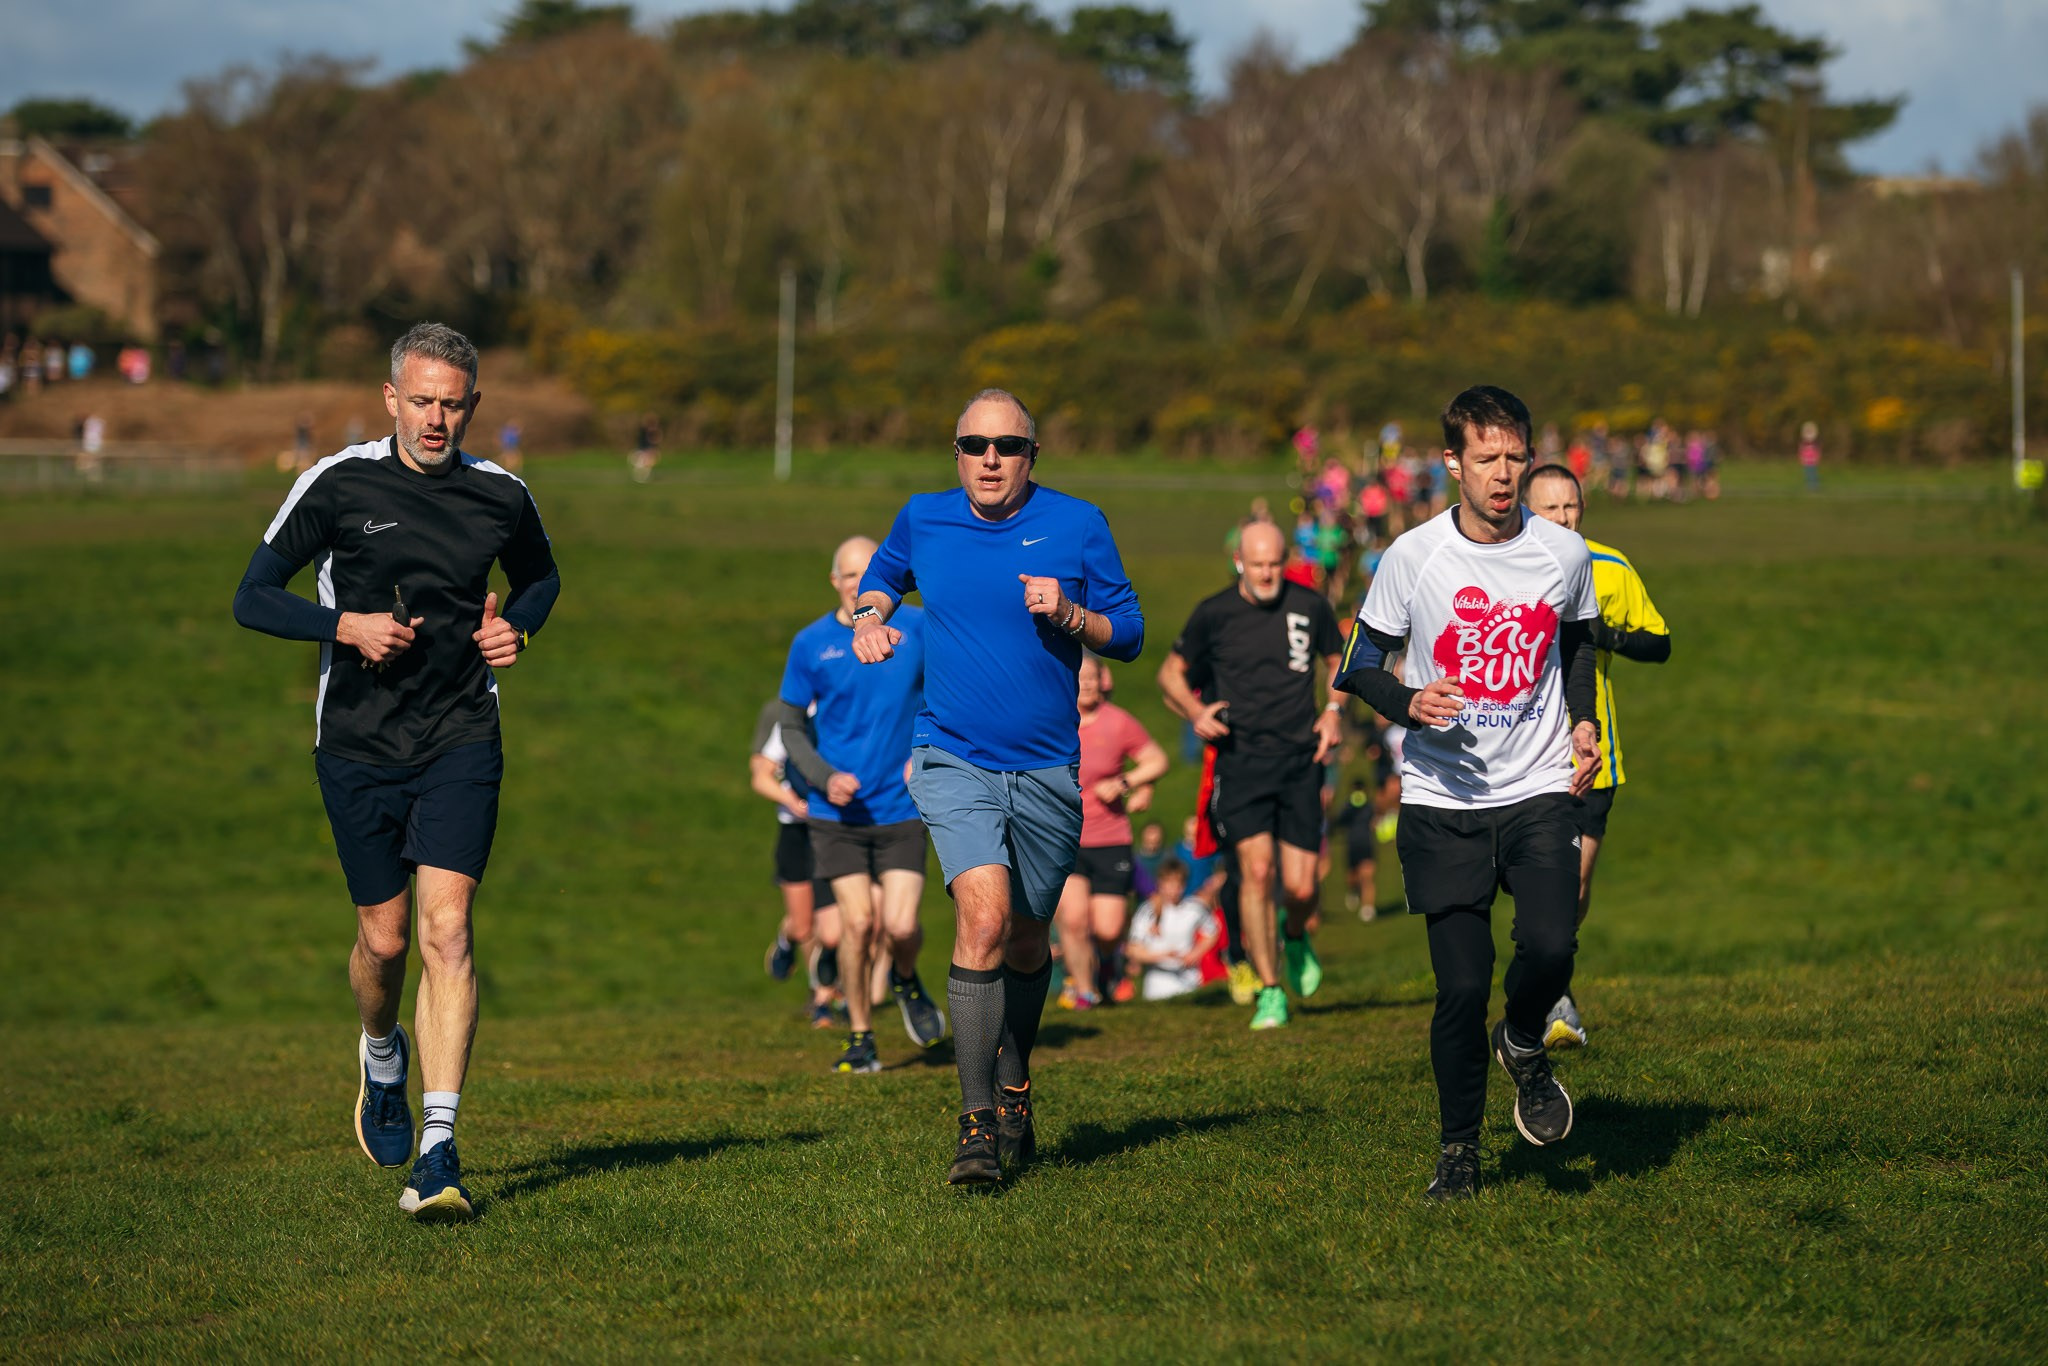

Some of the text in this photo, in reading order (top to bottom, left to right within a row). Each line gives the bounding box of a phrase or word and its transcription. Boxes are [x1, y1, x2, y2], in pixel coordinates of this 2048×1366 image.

[1454, 594, 1490, 614] Vitality
[1286, 612, 1310, 673] LDN
[1456, 620, 1546, 676] BAY
[1459, 652, 1535, 692] RUN
[1476, 714, 1512, 728] RUN
